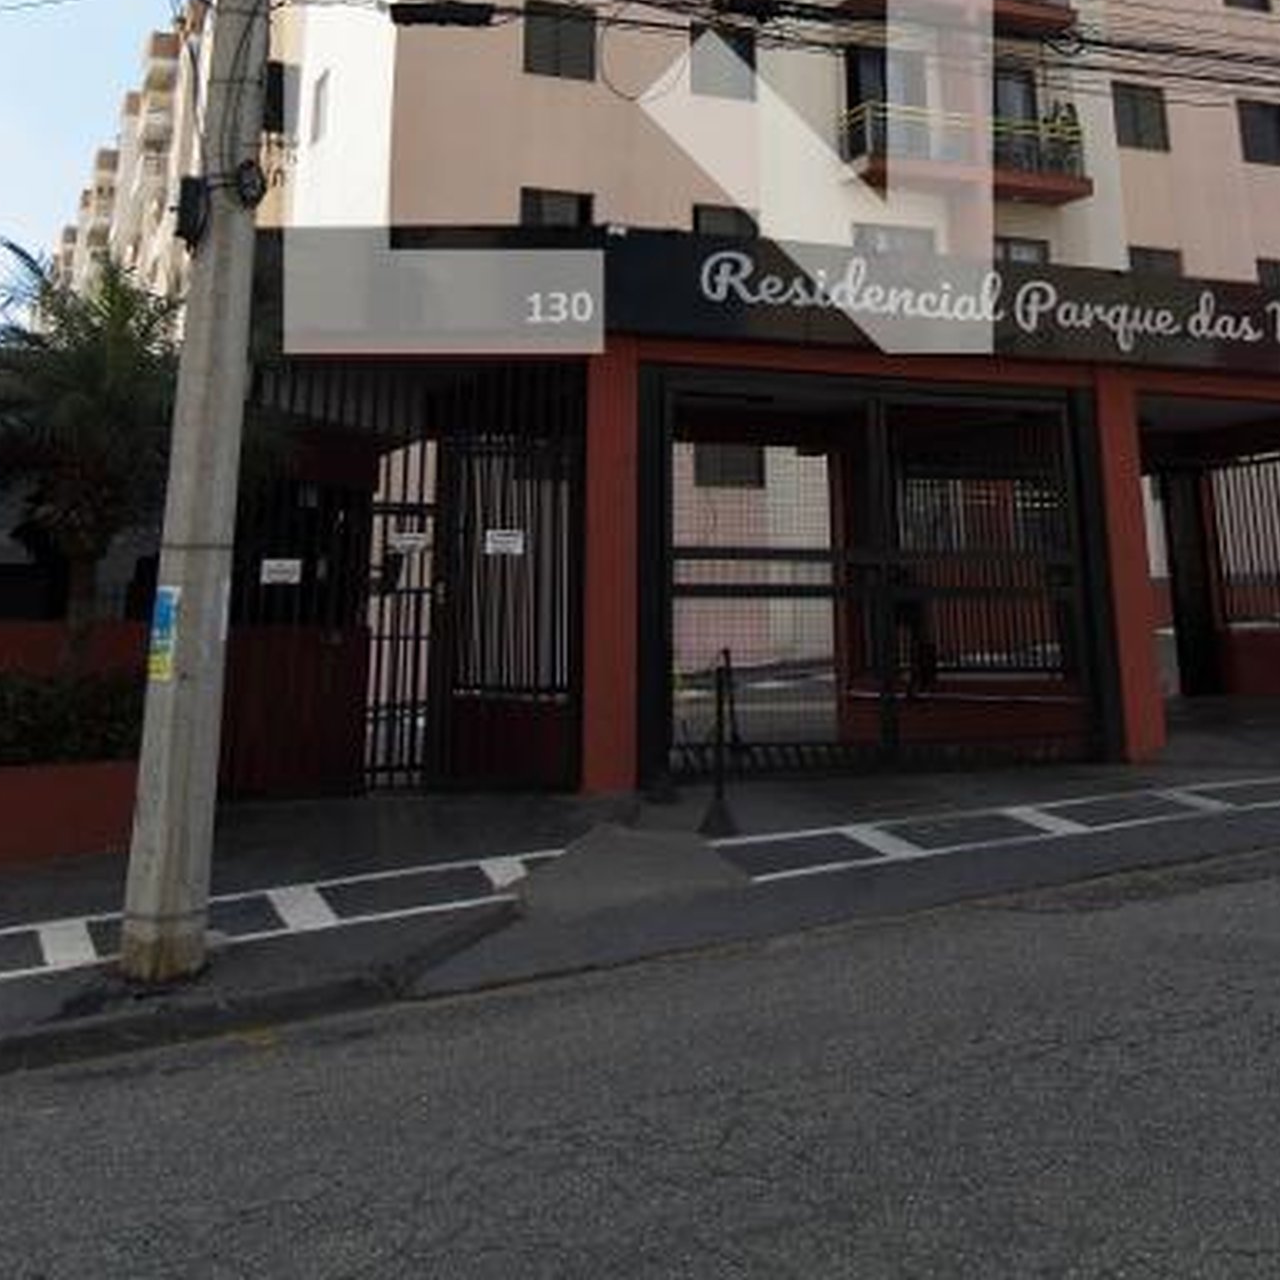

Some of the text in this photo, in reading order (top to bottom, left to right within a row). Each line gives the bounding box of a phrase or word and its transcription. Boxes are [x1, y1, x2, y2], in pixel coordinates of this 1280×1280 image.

[527, 292, 594, 322] 130
[699, 251, 1005, 321] Residencial
[1014, 280, 1181, 351] Parque
[1187, 290, 1263, 343] das
